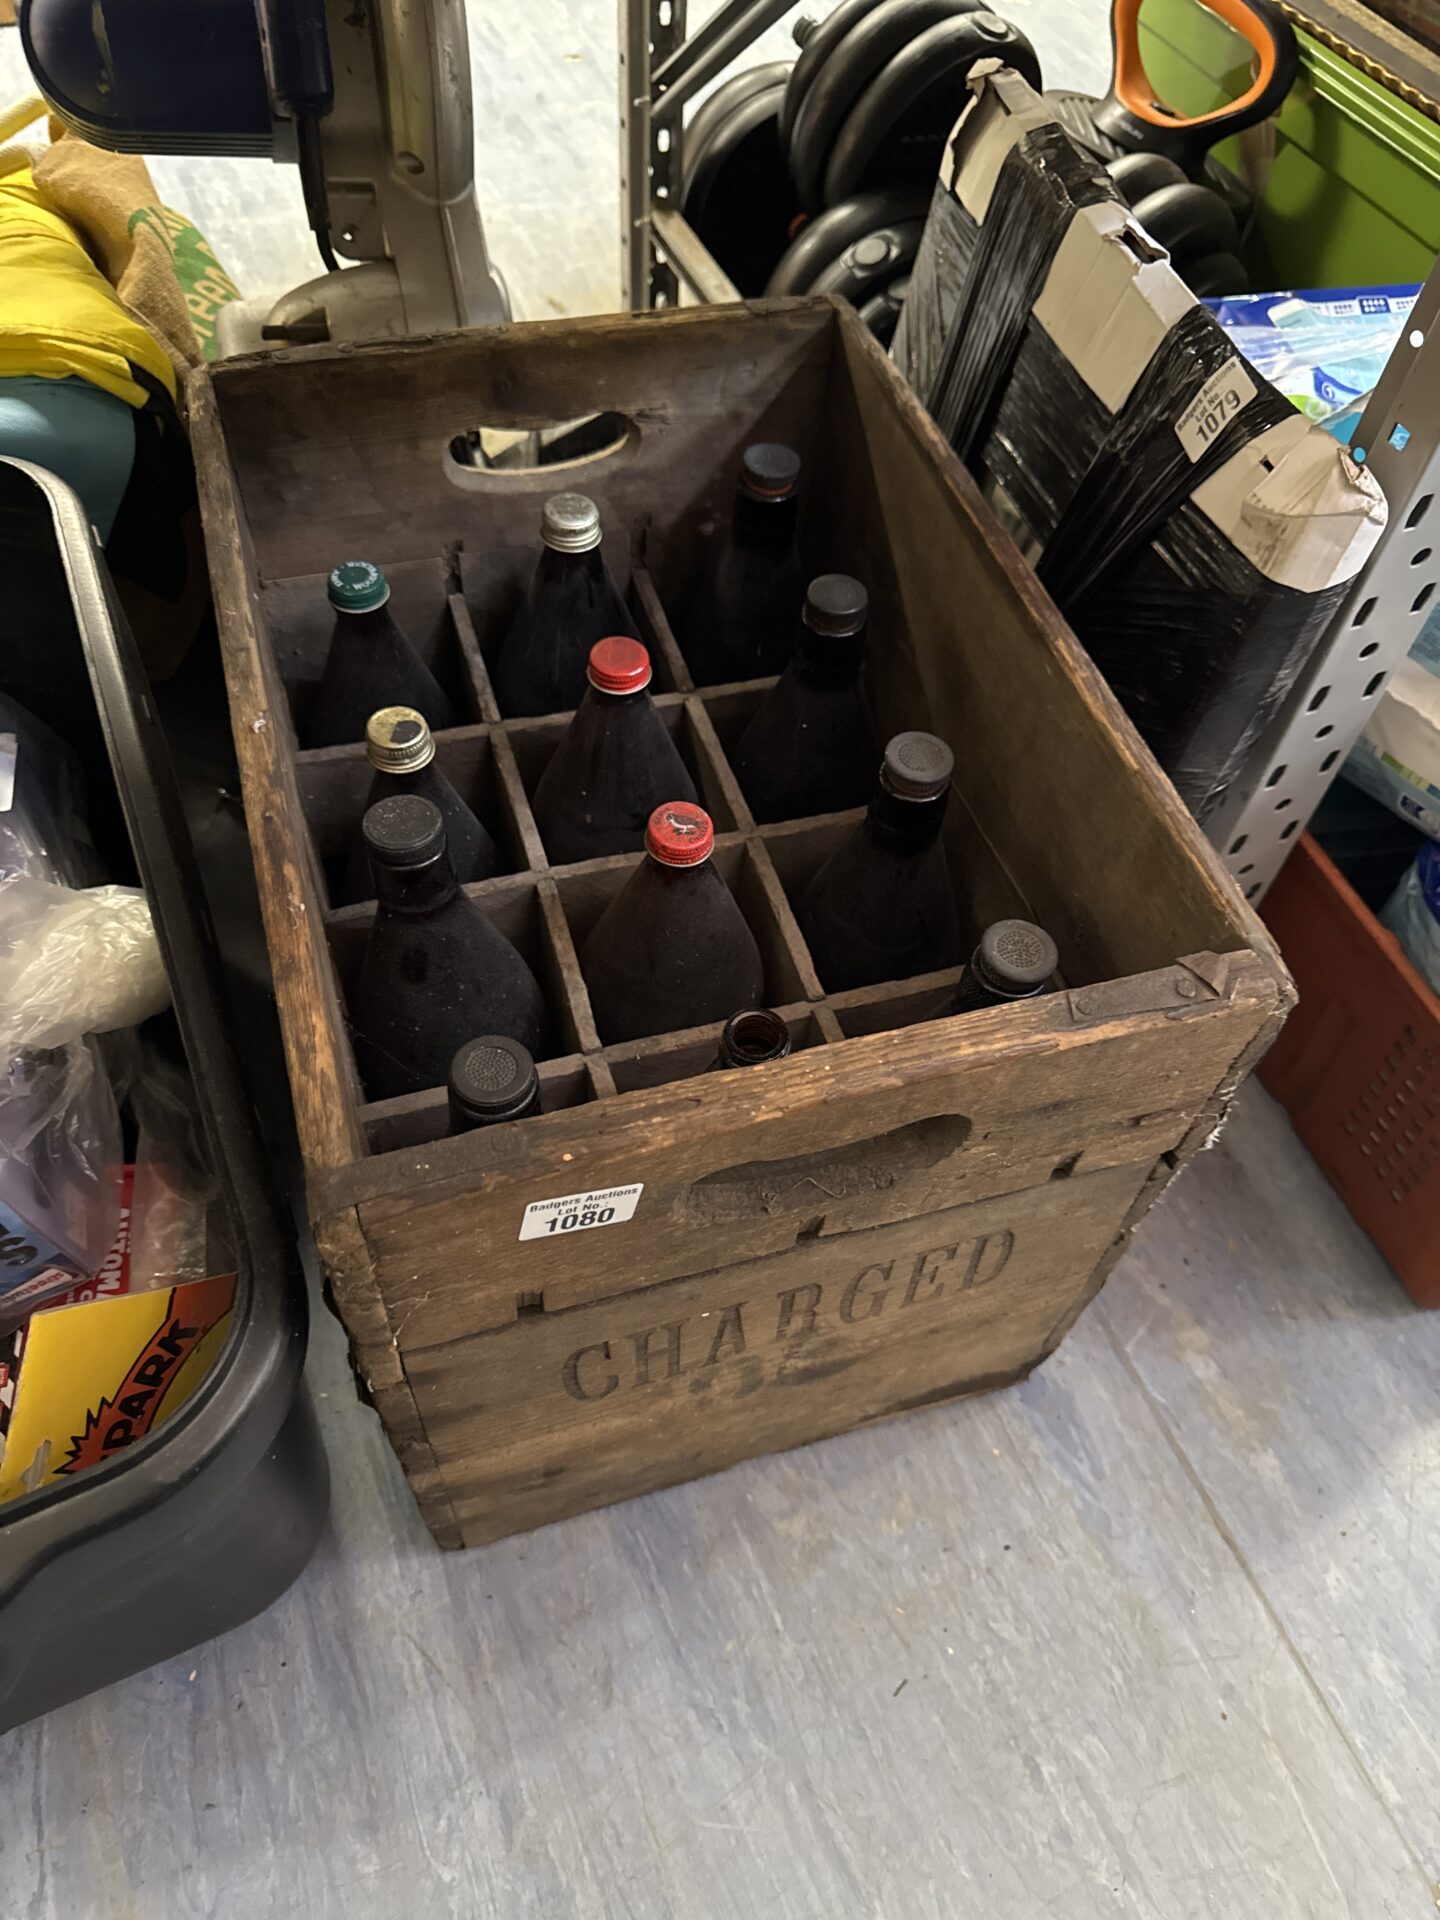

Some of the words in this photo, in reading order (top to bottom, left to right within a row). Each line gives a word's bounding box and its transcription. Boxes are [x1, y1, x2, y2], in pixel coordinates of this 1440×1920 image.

[184, 267, 242, 347] reen
[1195, 406, 1208, 422] Lot
[1195, 389, 1241, 442] 1079
[529, 1197, 581, 1213] Badgers
[585, 1187, 638, 1203] Auctions
[558, 1206, 578, 1216] Lot
[545, 1207, 615, 1233] 1080
[560, 1229, 1015, 1402] CHARGED
[99, 1318, 199, 1461] PARK
